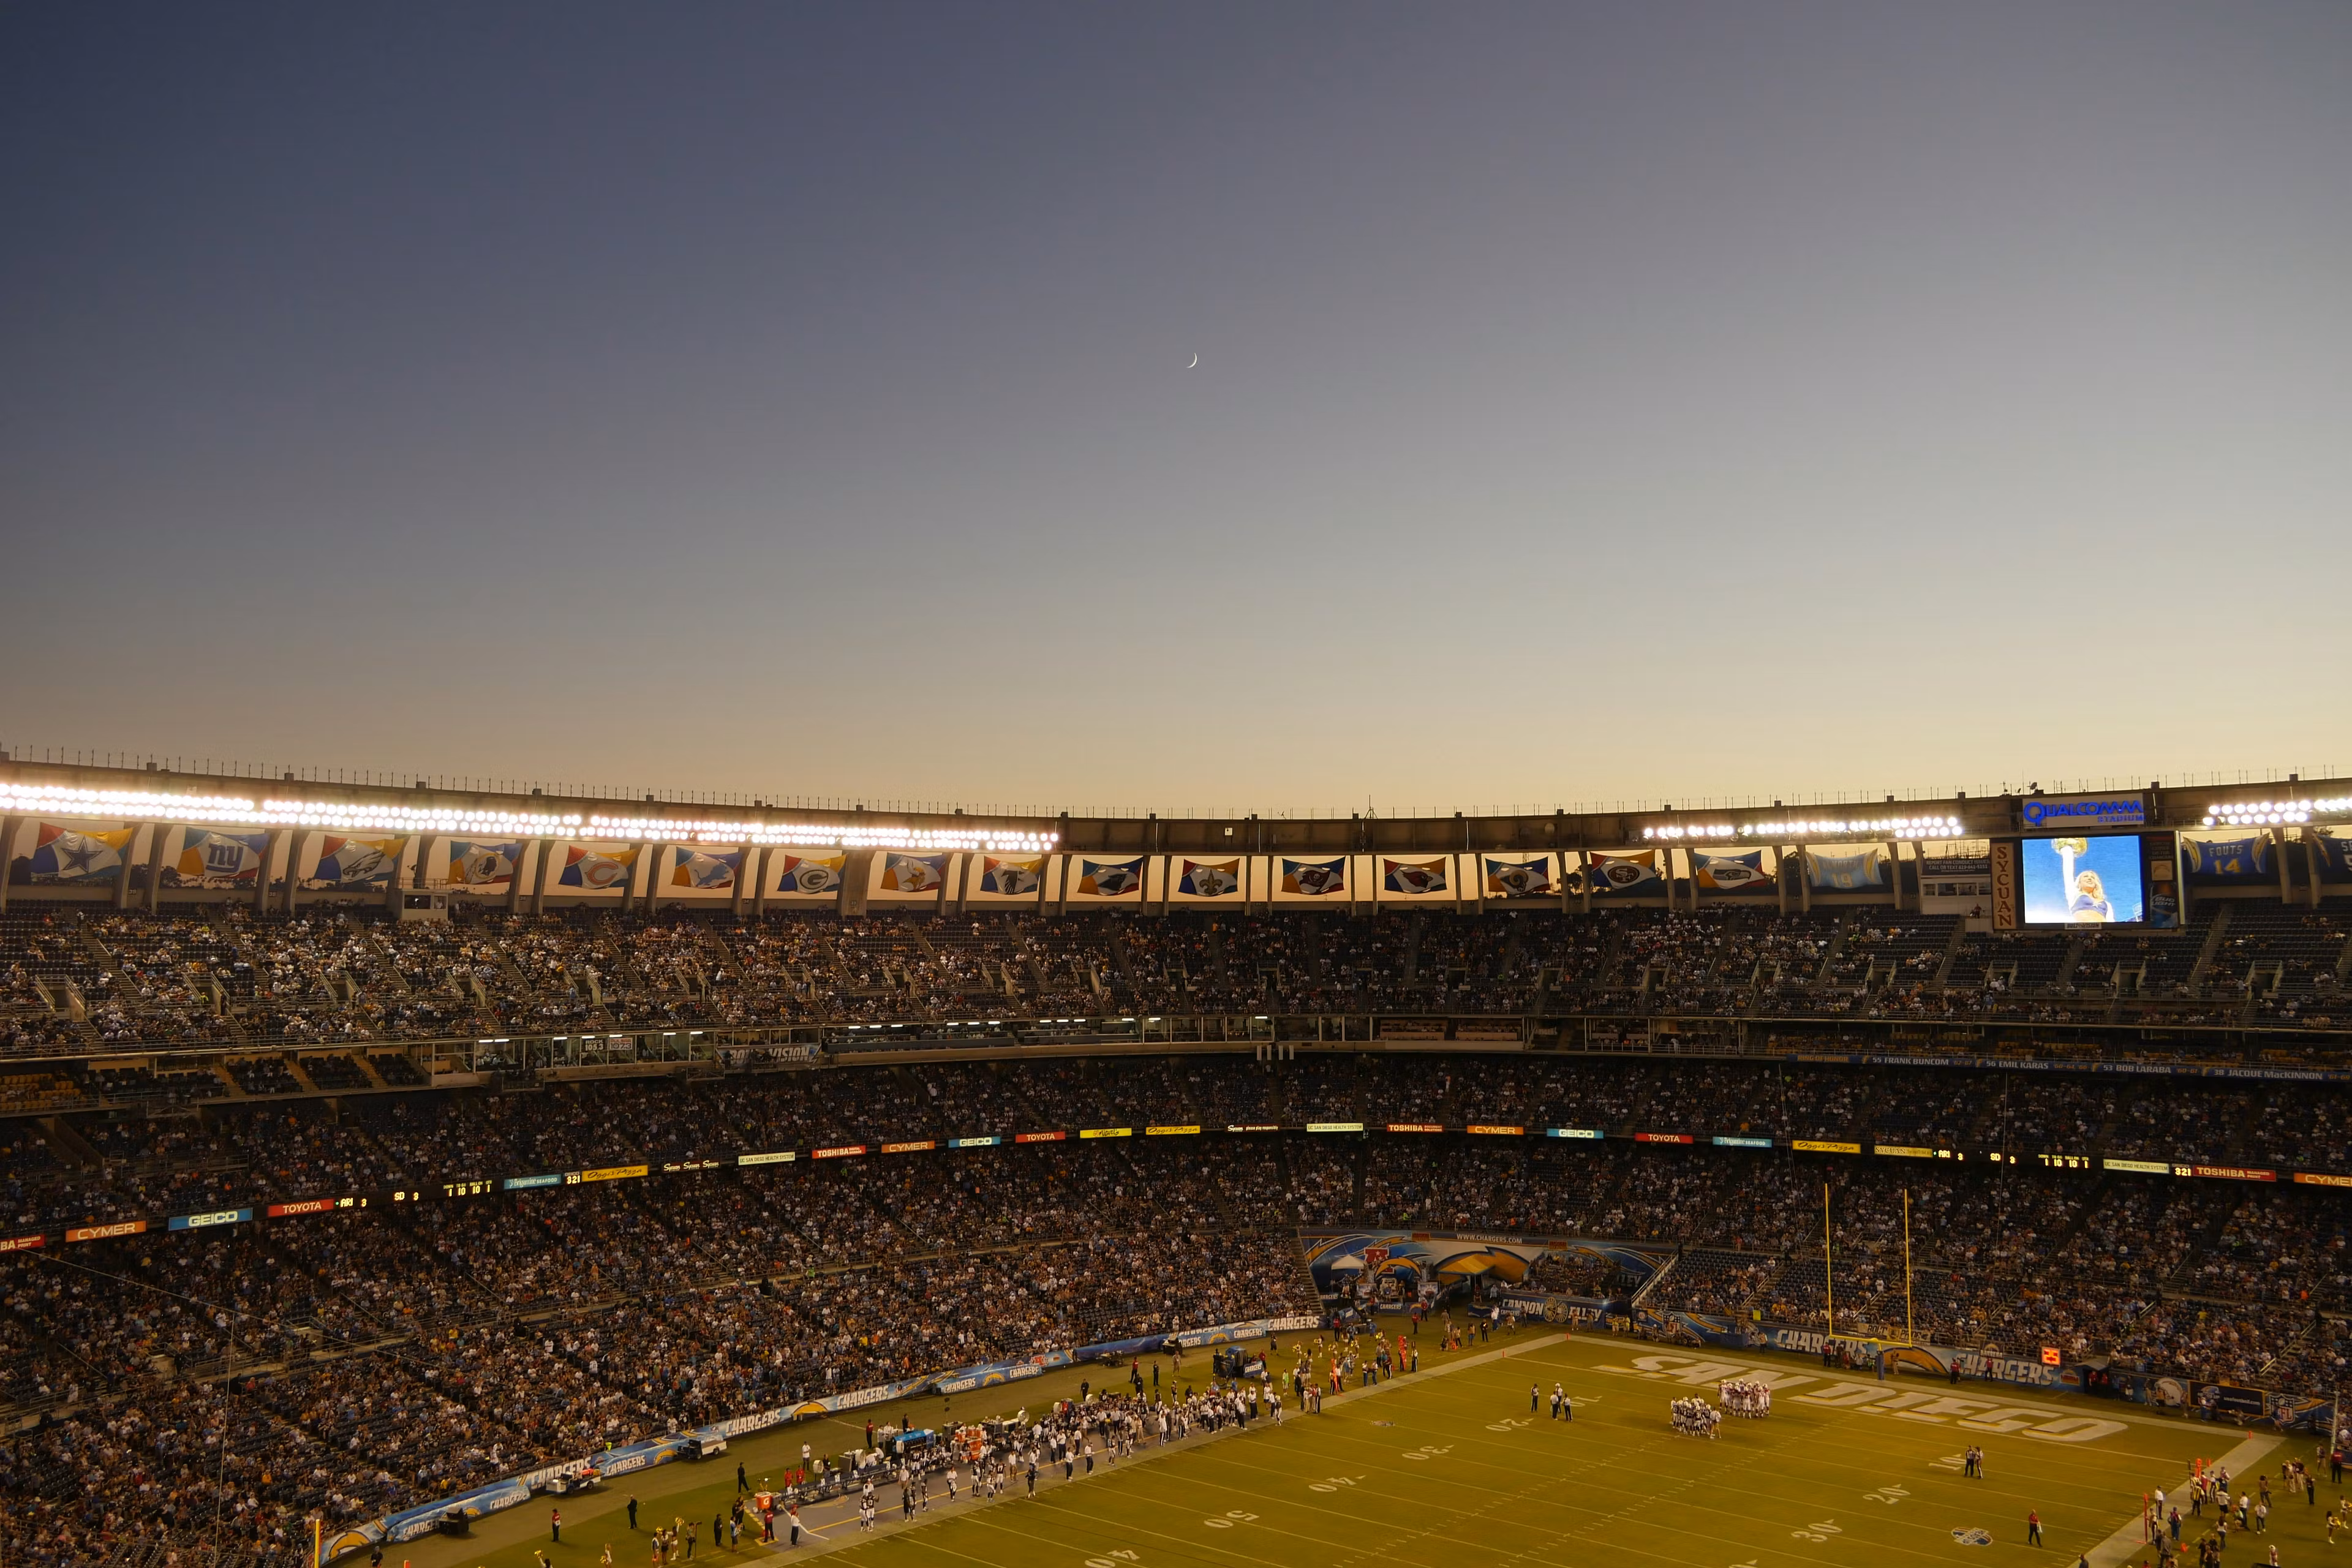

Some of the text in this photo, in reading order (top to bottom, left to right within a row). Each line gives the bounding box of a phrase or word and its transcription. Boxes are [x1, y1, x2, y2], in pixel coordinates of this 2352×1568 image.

[2023, 801, 2143, 827] QUALCOMM
[2209, 845, 2243, 858] FOUTS
[2214, 858, 2240, 874] 14
[1832, 873, 1852, 888] 19
[1996, 846, 2011, 926] SYCUAN
[769, 1047, 809, 1063] VISION
[2264, 1071, 2322, 1080] MacKINNON
[1558, 1129, 1594, 1138] GEICO
[889, 1142, 928, 1152] CYMER
[960, 1137, 992, 1147] GEICO
[817, 1148, 849, 1157] TOSHIBA
[1938, 1150, 1950, 1158] ARI
[2196, 1167, 2245, 1178] TOSHIBA
[2305, 1175, 2352, 1186] CYME
[341, 1197, 367, 1207] ARI 3
[394, 1191, 405, 1201] SD
[283, 1202, 322, 1213] TOYOTA
[189, 1211, 238, 1227] GEICO
[77, 1224, 135, 1240] CYMER
[1457, 1234, 1523, 1244] WWW.CHARGERS.COM
[1502, 1298, 1544, 1315] CANNON
[1268, 1316, 1319, 1331] CHARGERS
[1868, 1324, 1888, 1334] BOLT
[1901, 1328, 1921, 1338] PRDE
[1234, 1328, 1262, 1338] CHARGERS
[1774, 1329, 1867, 1357] CHARGERS
[2043, 1349, 2059, 1365] 25
[1010, 1366, 1039, 1378] CHARGERS
[1954, 1354, 2053, 1385] CHARGERS
[943, 1378, 976, 1393] CHARGERS
[837, 1385, 889, 1409] CHARGERS
[1591, 1356, 2128, 1442] SAN DIEGO
[726, 1409, 781, 1436] CHARGERS
[531, 1457, 591, 1488] CHARGERS
[606, 1455, 645, 1476] CHARGERS
[403, 1518, 440, 1540] CHARGER
